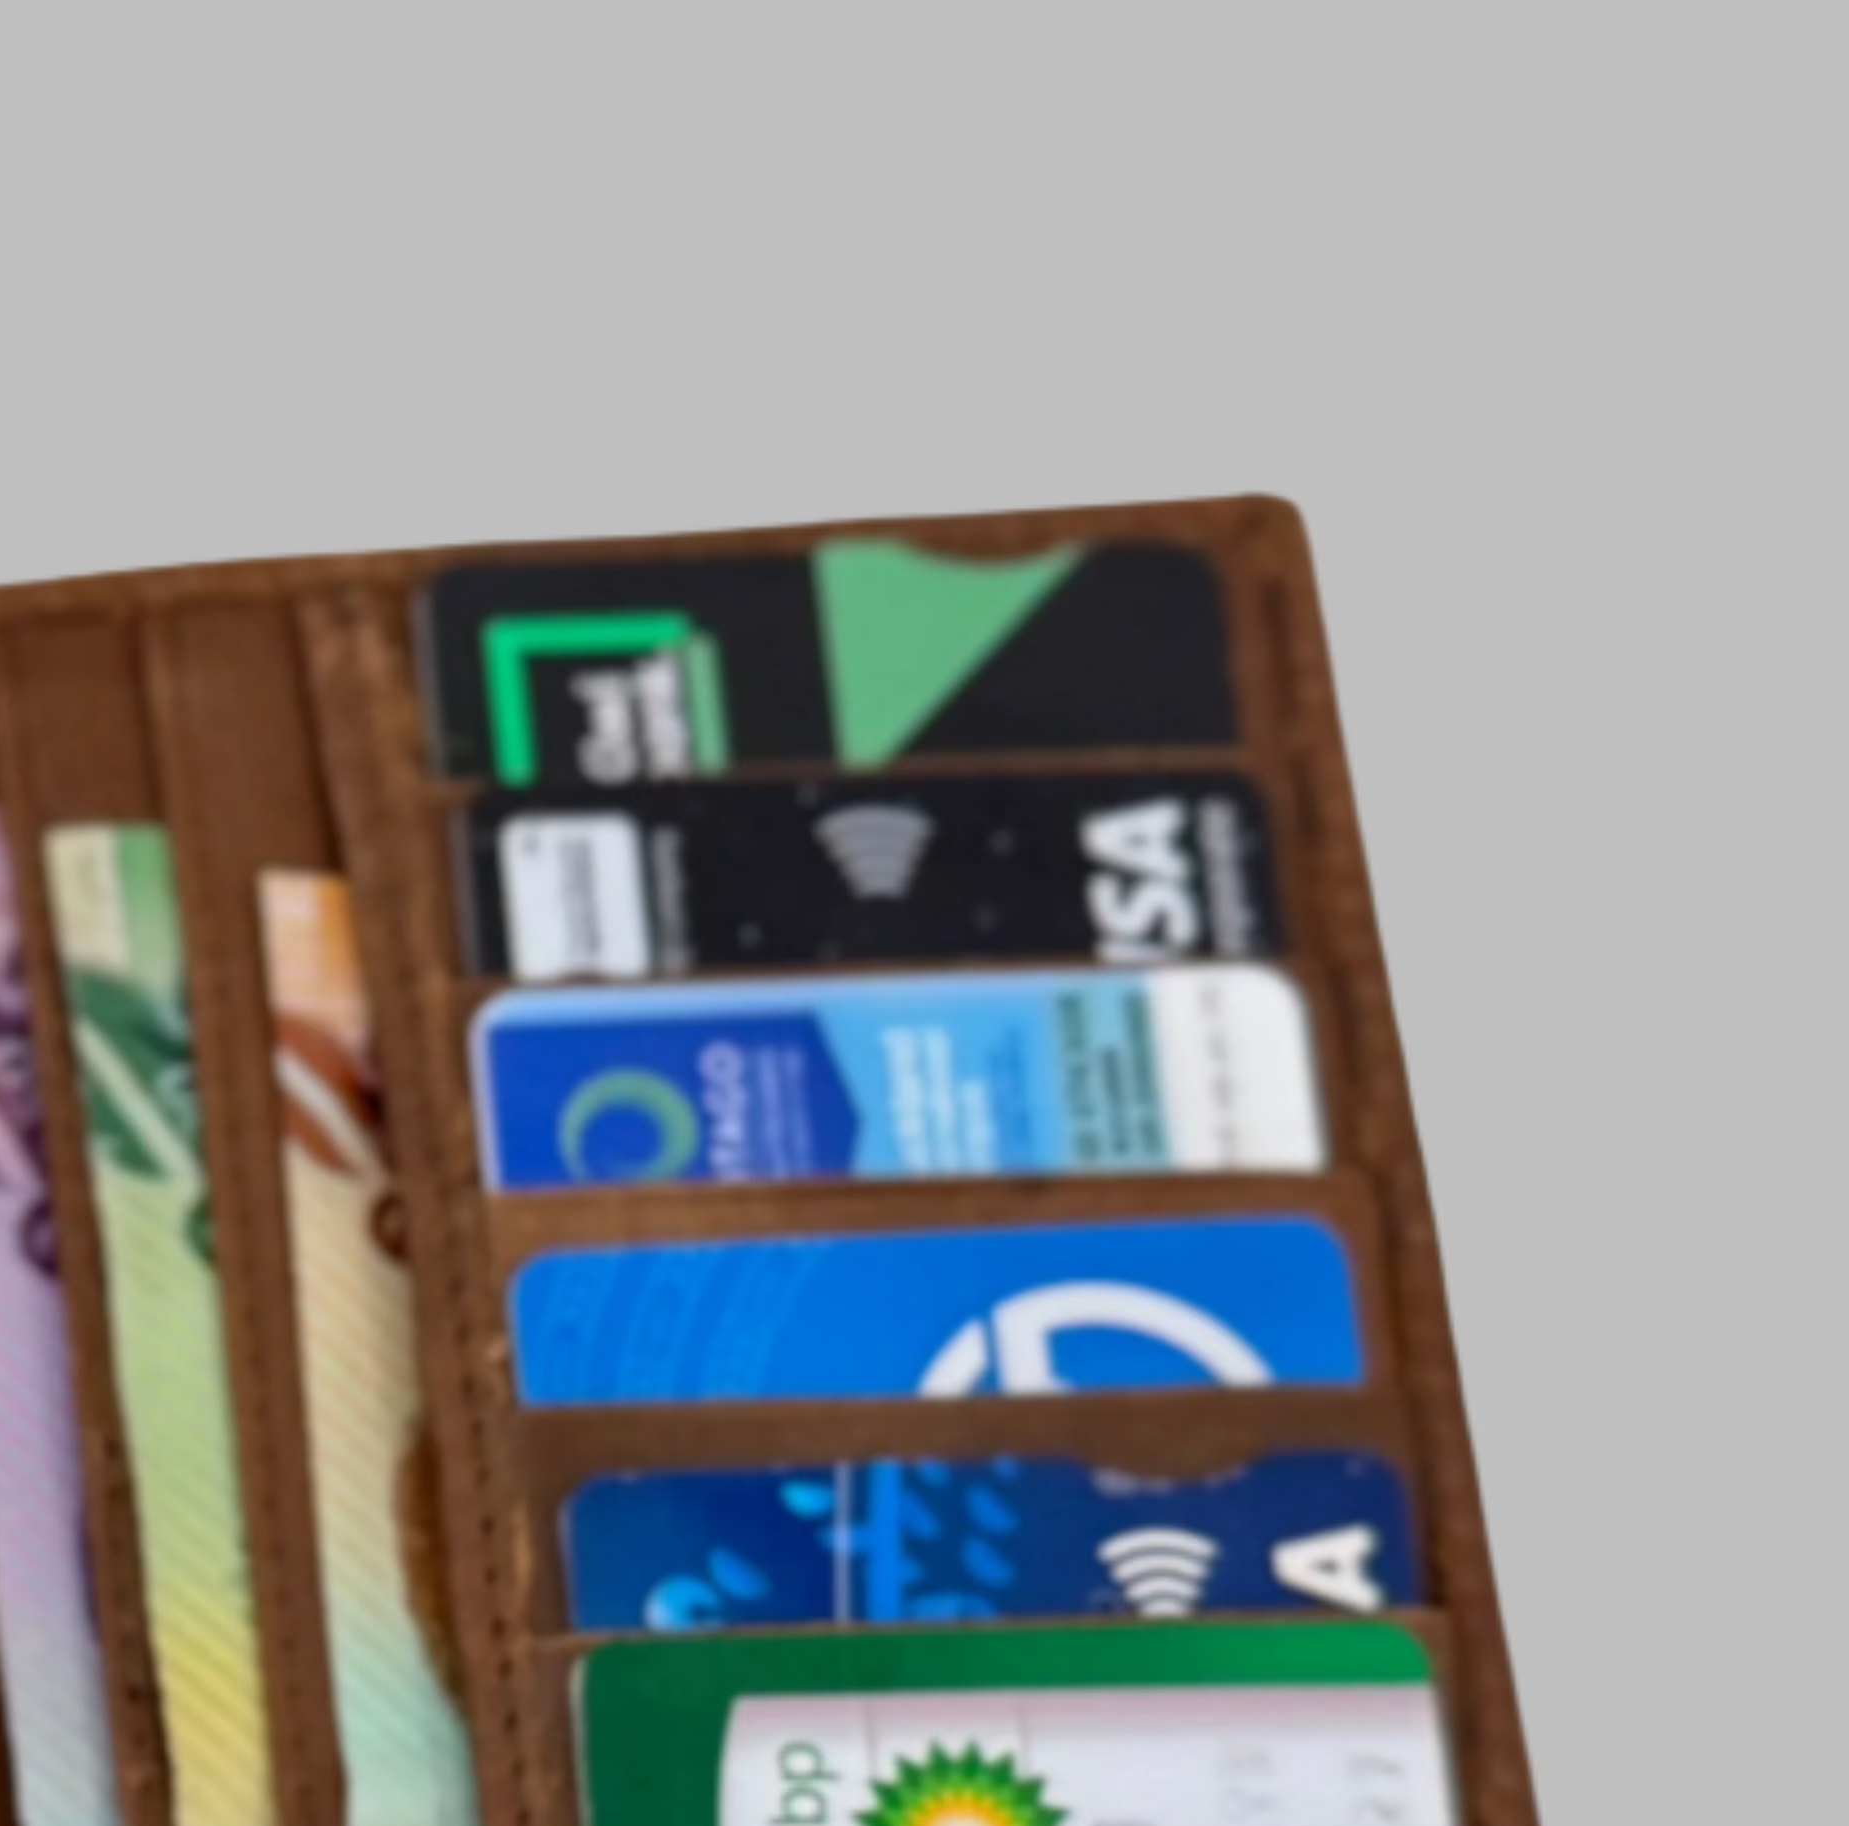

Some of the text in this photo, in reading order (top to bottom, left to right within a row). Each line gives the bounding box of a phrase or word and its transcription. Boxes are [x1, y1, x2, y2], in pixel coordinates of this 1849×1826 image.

[1084, 799, 1198, 962] ISA
[699, 1040, 751, 1182] TAGO
[773, 1741, 841, 1826] bp
